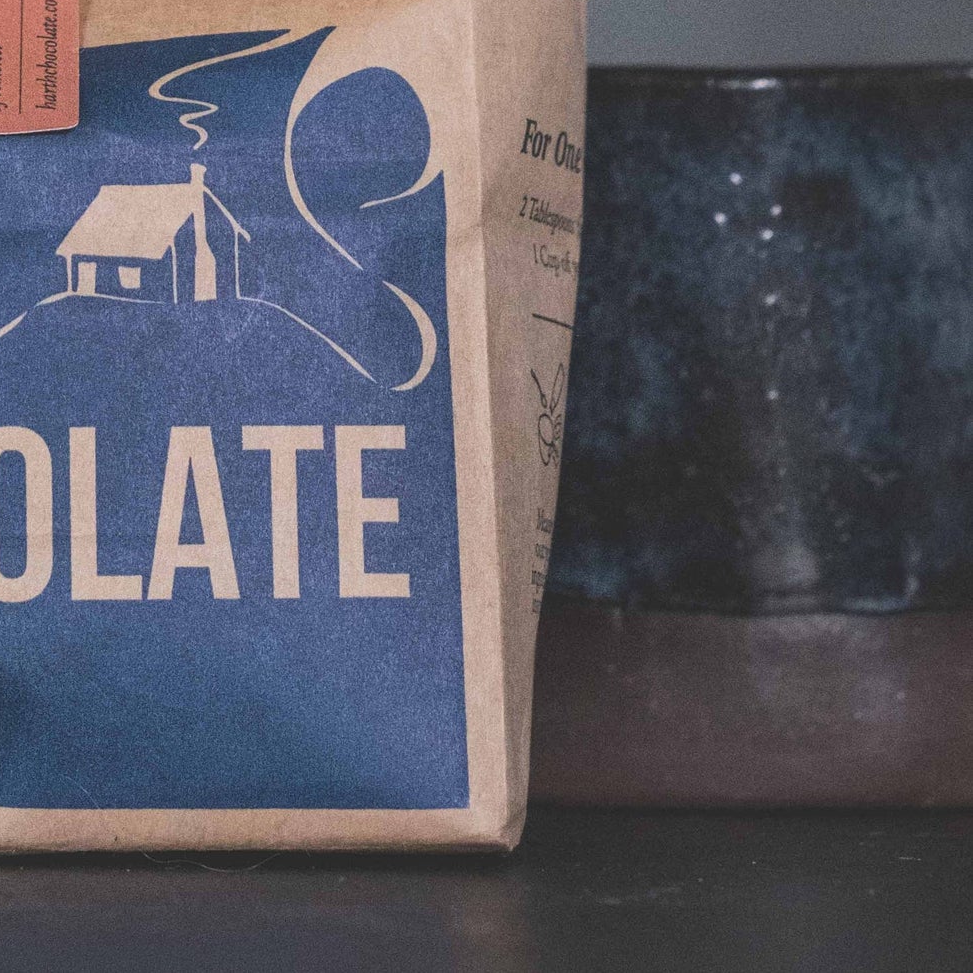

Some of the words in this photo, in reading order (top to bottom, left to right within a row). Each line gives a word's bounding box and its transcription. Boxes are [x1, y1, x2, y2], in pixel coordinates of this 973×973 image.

[520, 118, 552, 161] For
[554, 131, 582, 174] One
[519, 195, 528, 217] 2
